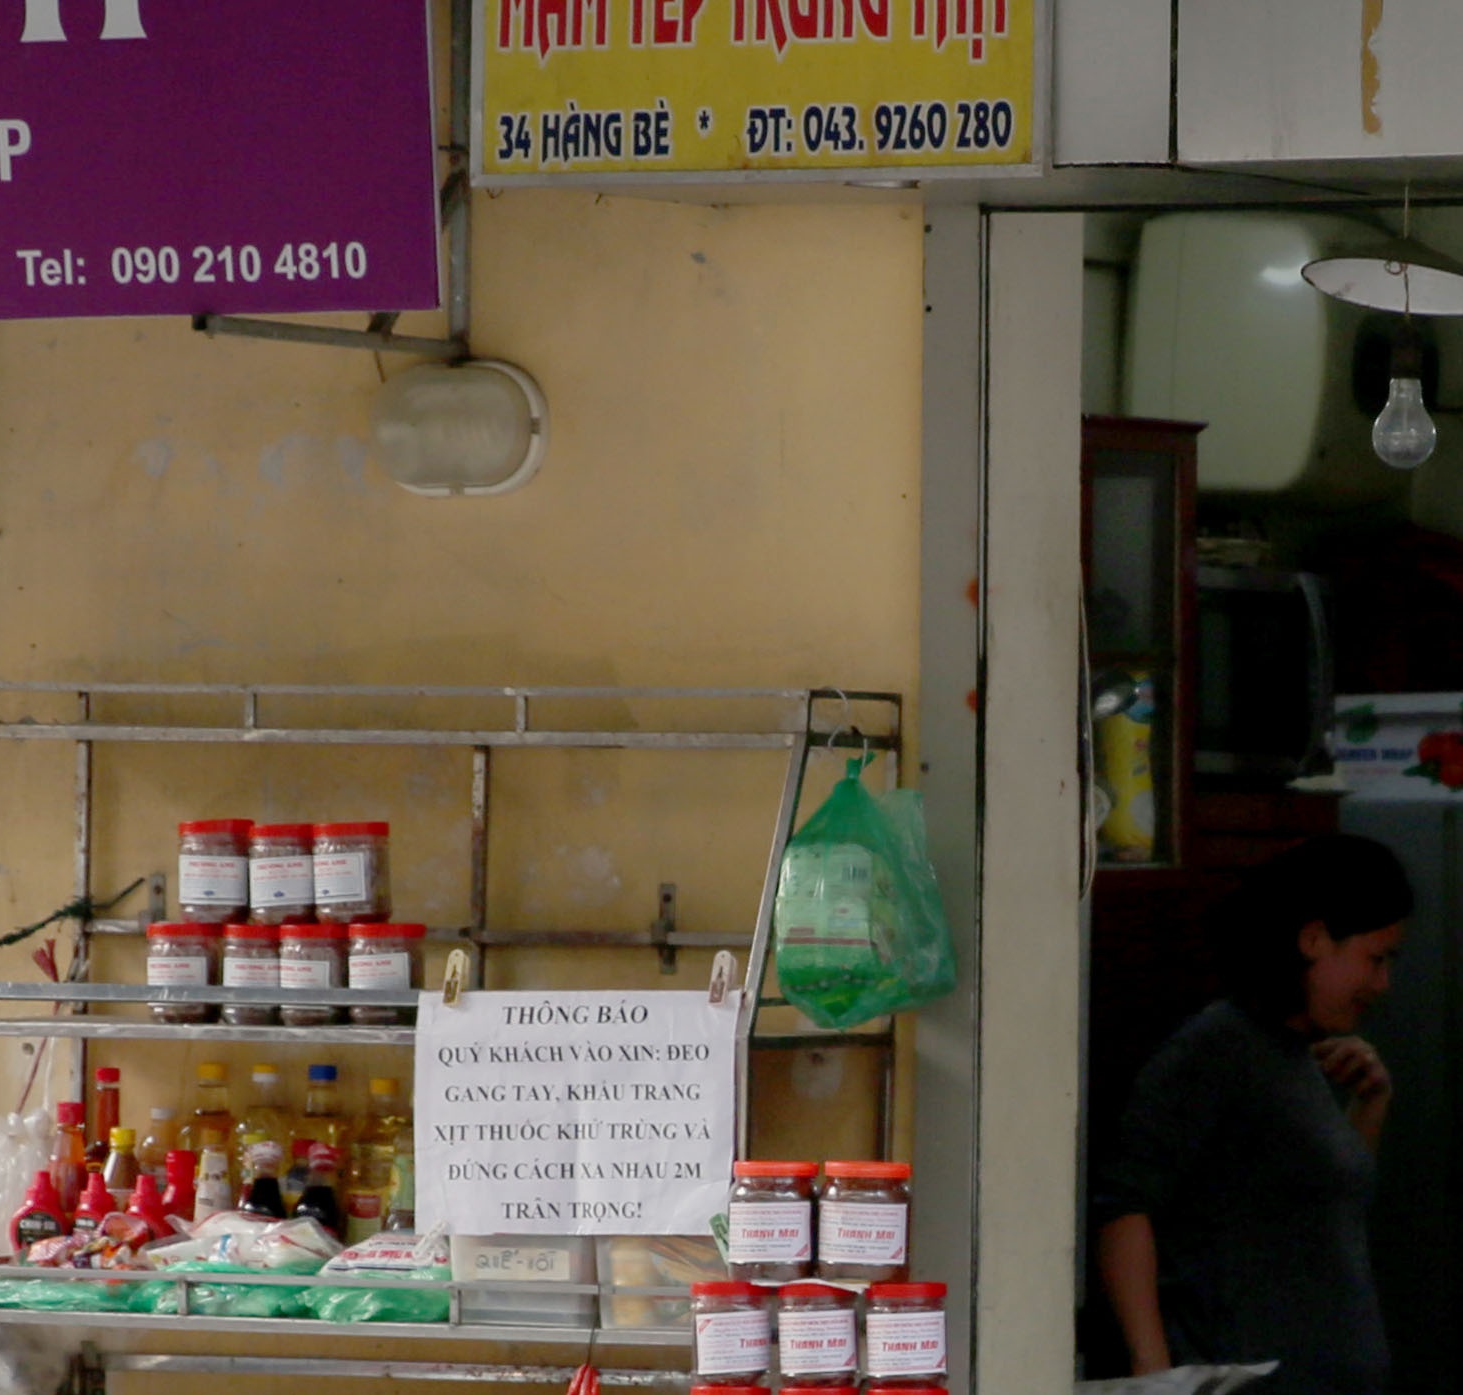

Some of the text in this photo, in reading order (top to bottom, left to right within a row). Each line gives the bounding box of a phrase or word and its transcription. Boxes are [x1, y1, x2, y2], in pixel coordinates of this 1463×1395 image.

[498, 100, 671, 163] 34 HÀNG BÈ
[746, 101, 1013, 154] ĐT: 043. 9260 280
[17, 242, 368, 288] Tel: 090 210 4810
[503, 1000, 648, 1024] THÔNG BÁO
[438, 1041, 710, 1066] QUÝ KHÁCH VÀO XIN: ĐEO
[445, 1084, 506, 1102] GANG
[512, 1084, 561, 1103] TAY,
[631, 1083, 700, 1101] TRANG
[434, 1125, 469, 1145] XỊT
[607, 1118, 677, 1140] TRÙNG
[684, 1118, 711, 1140] VÀ
[448, 1157, 701, 1180] ĐỨNG CÁCH XA NHAU 2M
[502, 1198, 643, 1222] TRÂN TRỌNG!
